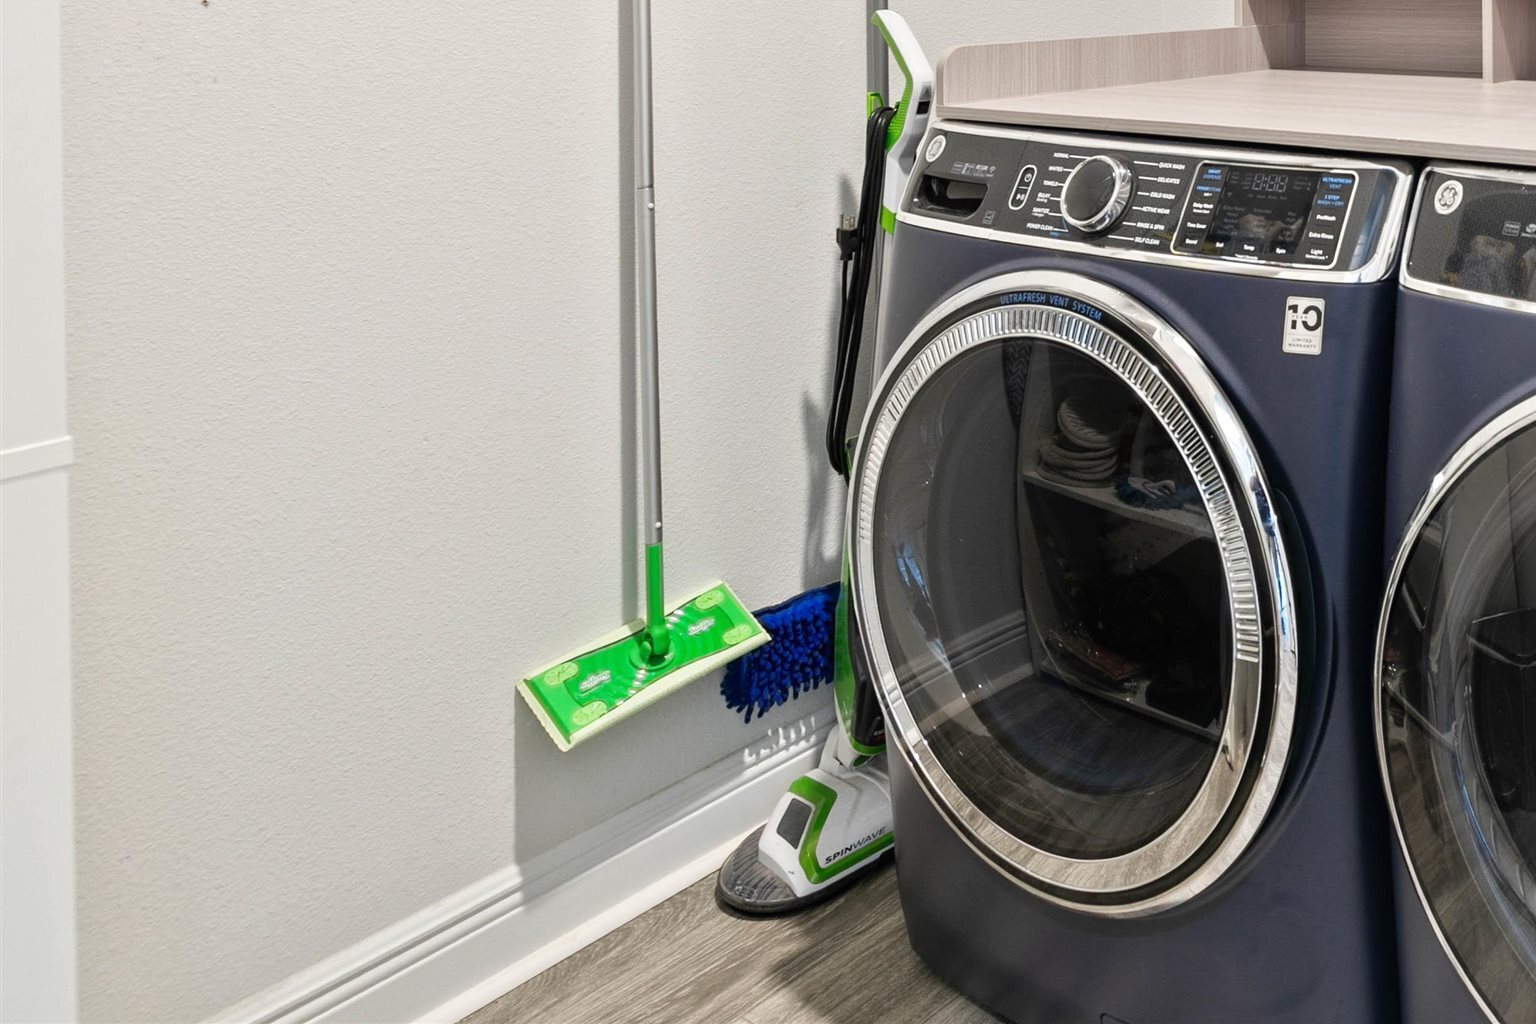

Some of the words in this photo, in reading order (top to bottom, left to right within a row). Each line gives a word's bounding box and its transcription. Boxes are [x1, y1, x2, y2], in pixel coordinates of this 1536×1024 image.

[1000, 292, 1046, 304] ULTRAFRESH
[1049, 294, 1070, 307] VENT
[1072, 301, 1103, 321] SYSTEM
[1288, 304, 1322, 332] 10
[824, 826, 887, 865] SPINWAVE
